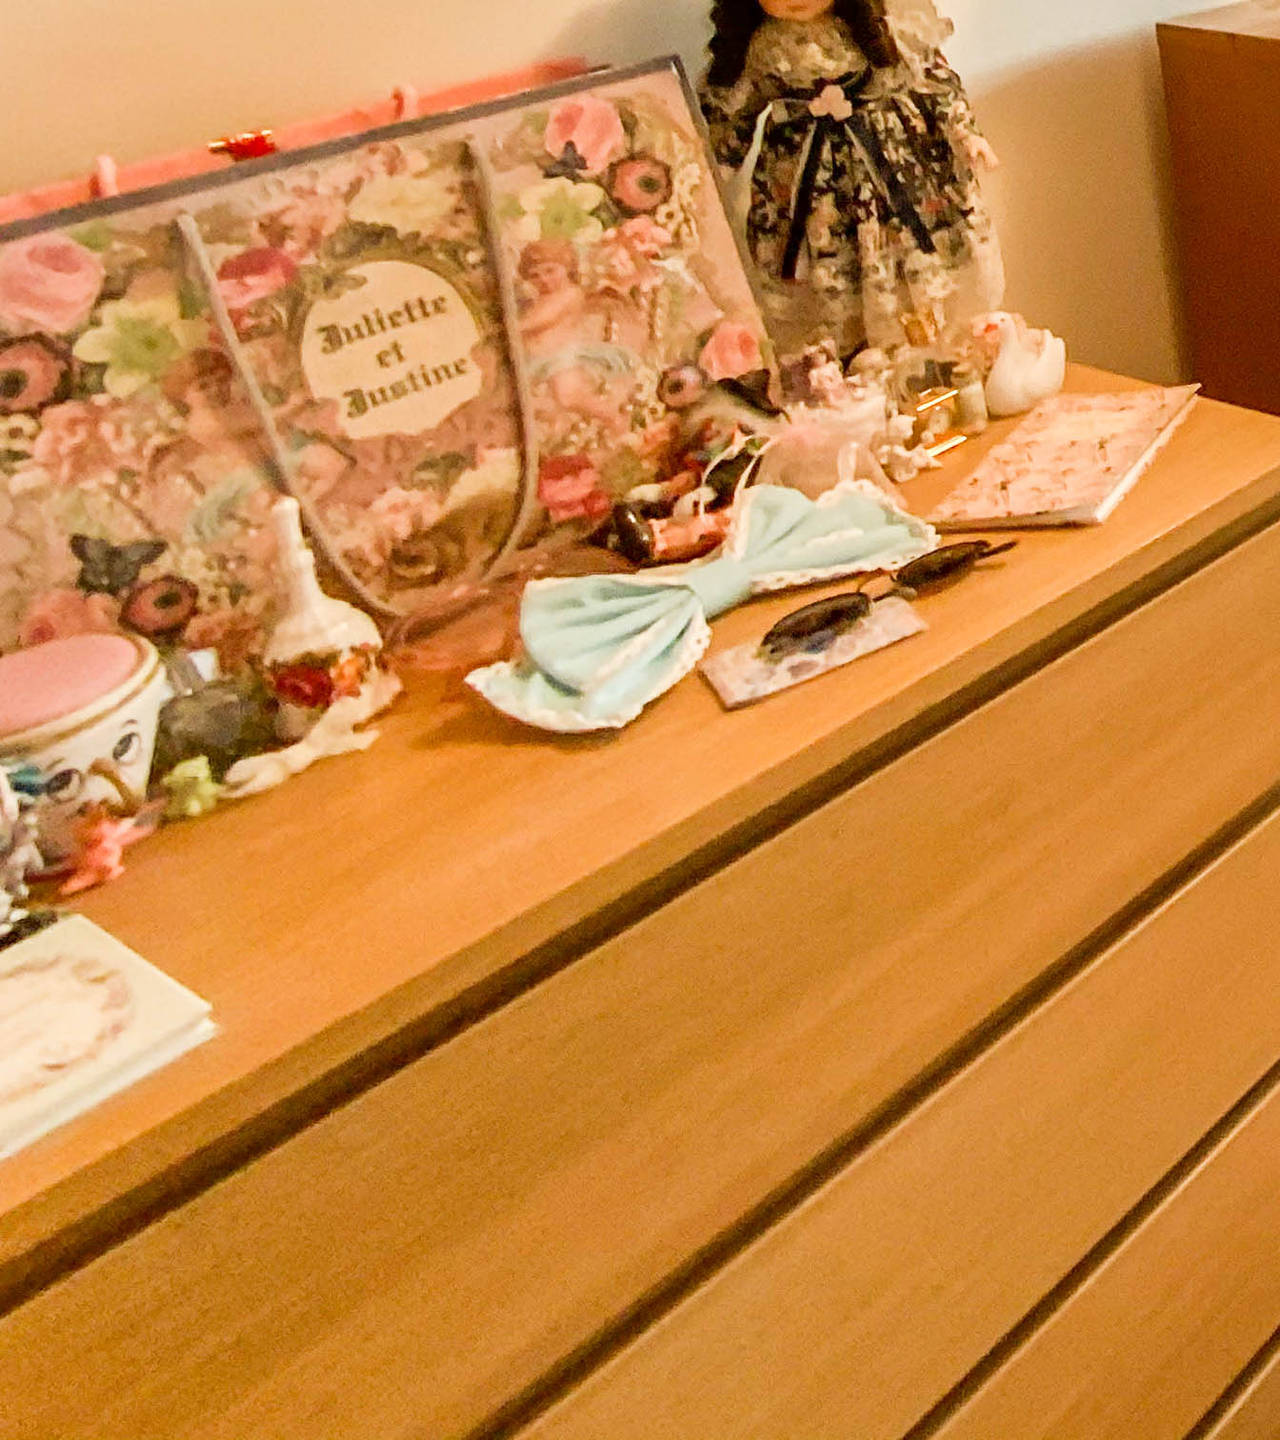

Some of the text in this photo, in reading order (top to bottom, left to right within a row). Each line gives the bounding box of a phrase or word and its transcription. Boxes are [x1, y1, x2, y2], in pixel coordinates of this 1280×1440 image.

[316, 295, 447, 354] Juliette
[376, 339, 406, 369] et
[342, 358, 468, 418] Justine
